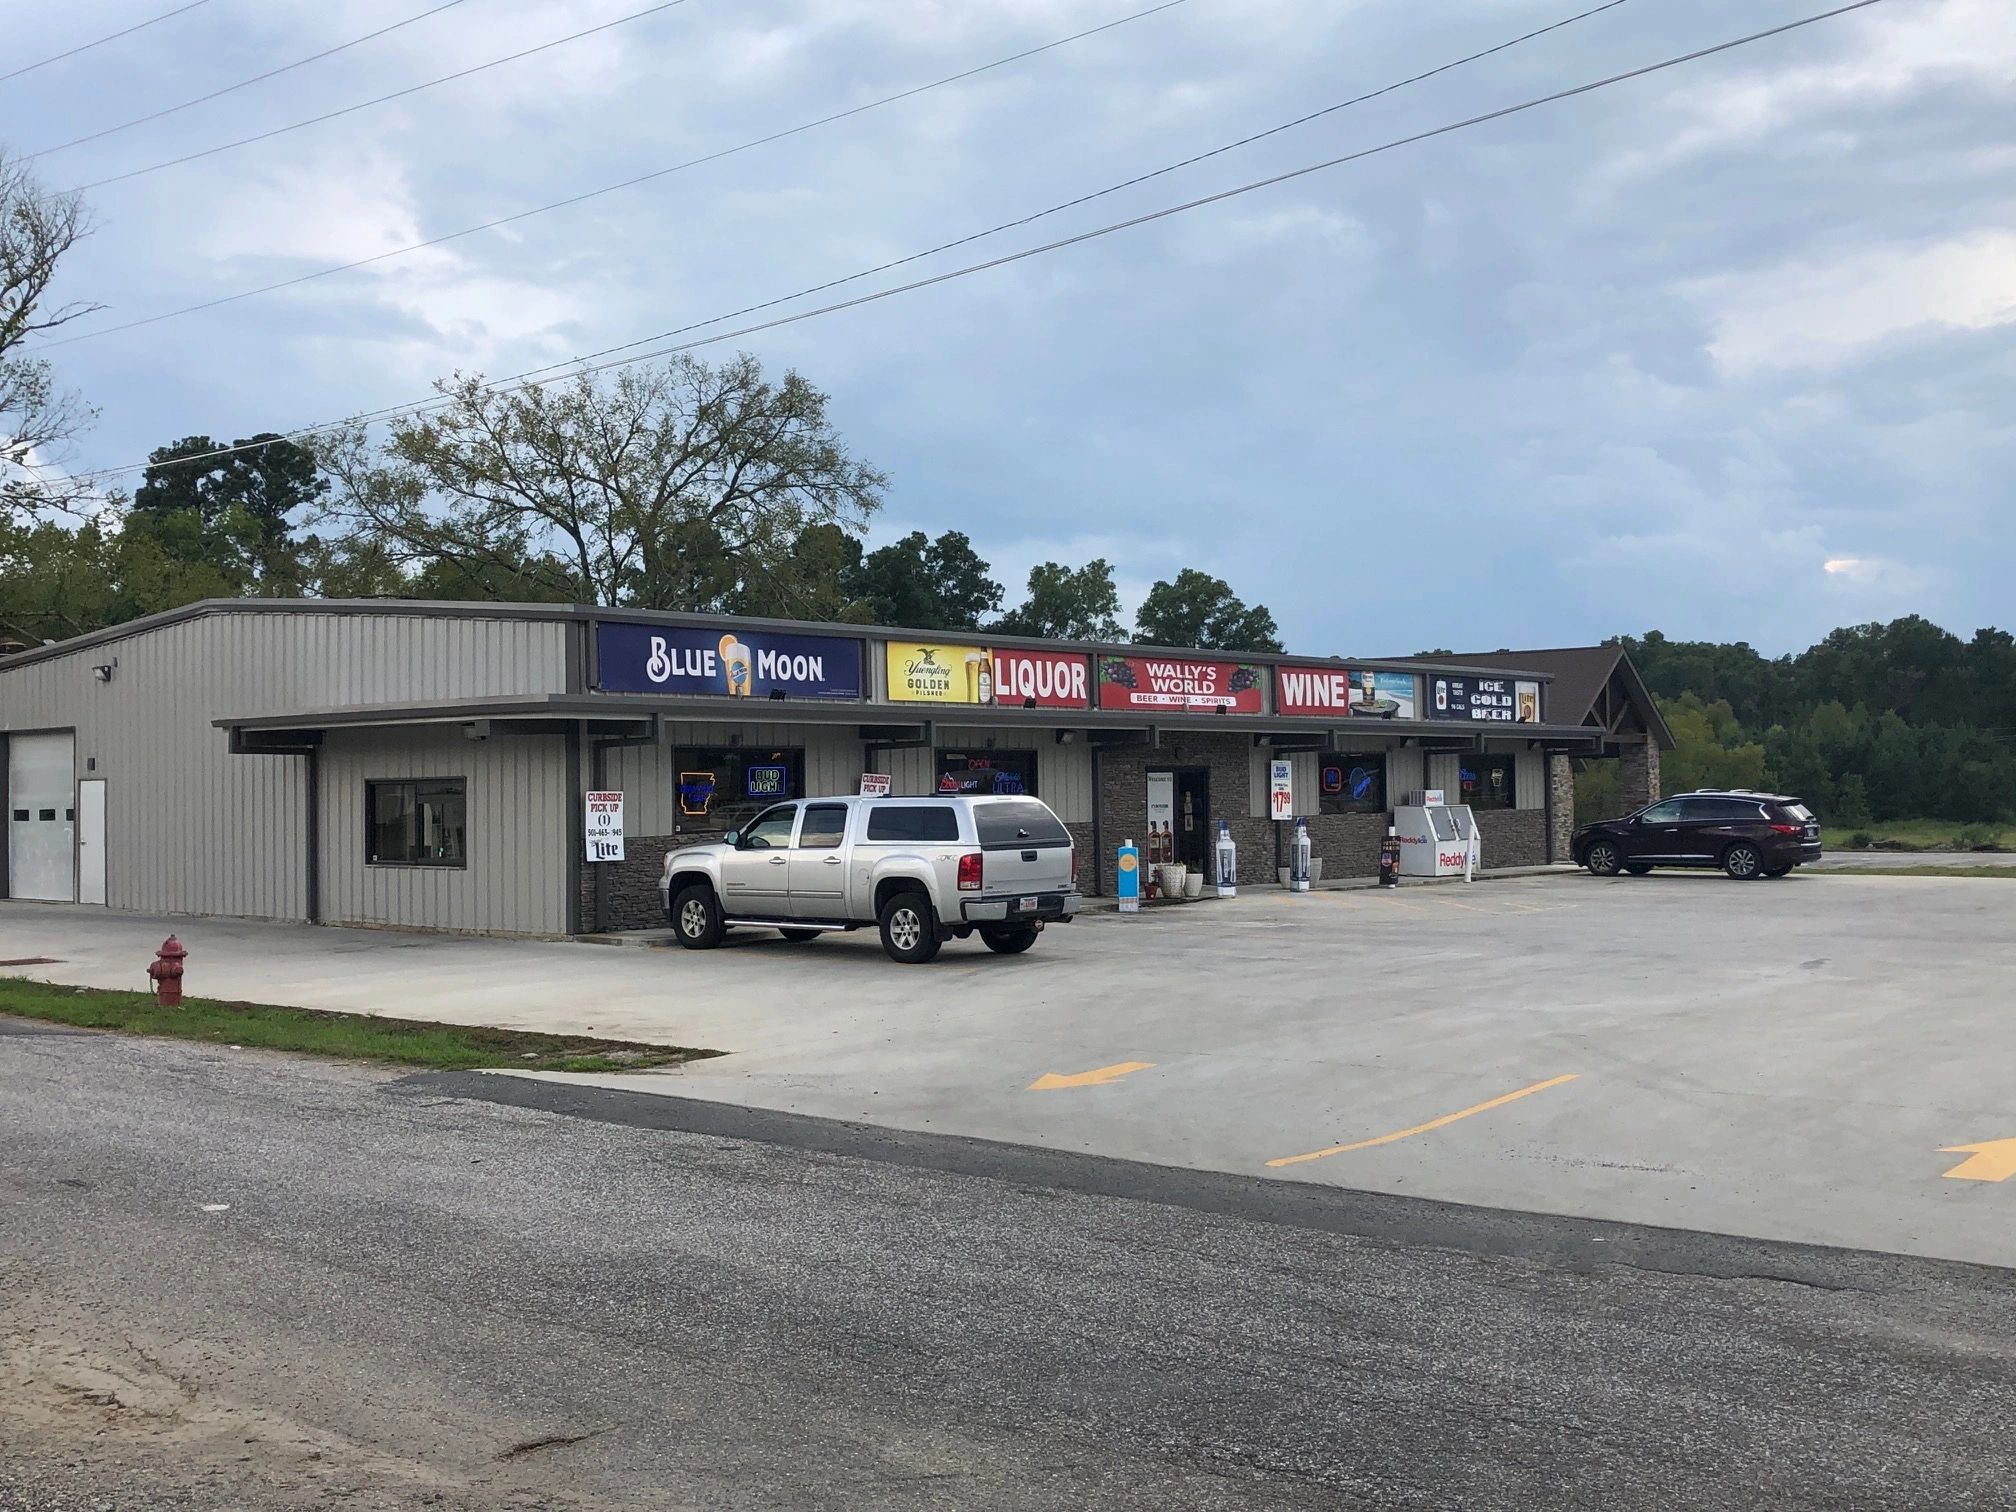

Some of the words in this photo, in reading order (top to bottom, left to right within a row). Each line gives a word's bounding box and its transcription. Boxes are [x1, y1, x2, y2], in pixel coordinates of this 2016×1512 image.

[904, 659, 953, 676] Yuengling
[1146, 663, 1217, 680] WALLY'S
[907, 678, 950, 690] GOLDEN
[994, 657, 1087, 699] LIQUOR
[1151, 678, 1216, 694] WORLD
[1281, 673, 1345, 708] WINE
[1478, 680, 1505, 692] ICE
[1136, 694, 1158, 703] BEER
[1168, 695, 1192, 704] WINE
[1201, 697, 1231, 705] SPIRITS
[1470, 693, 1512, 706] COLD
[1471, 708, 1512, 720] BEER
[755, 769, 780, 781] BUD
[862, 775, 890, 785] CURBSIDE
[863, 784, 877, 793] PICK
[878, 785, 887, 794] UP
[960, 780, 978, 789] LIGHT
[588, 792, 622, 802] CURBSIDE
[590, 803, 608, 812] PICK
[610, 803, 619, 812] UP
[594, 842, 619, 859] Lite
